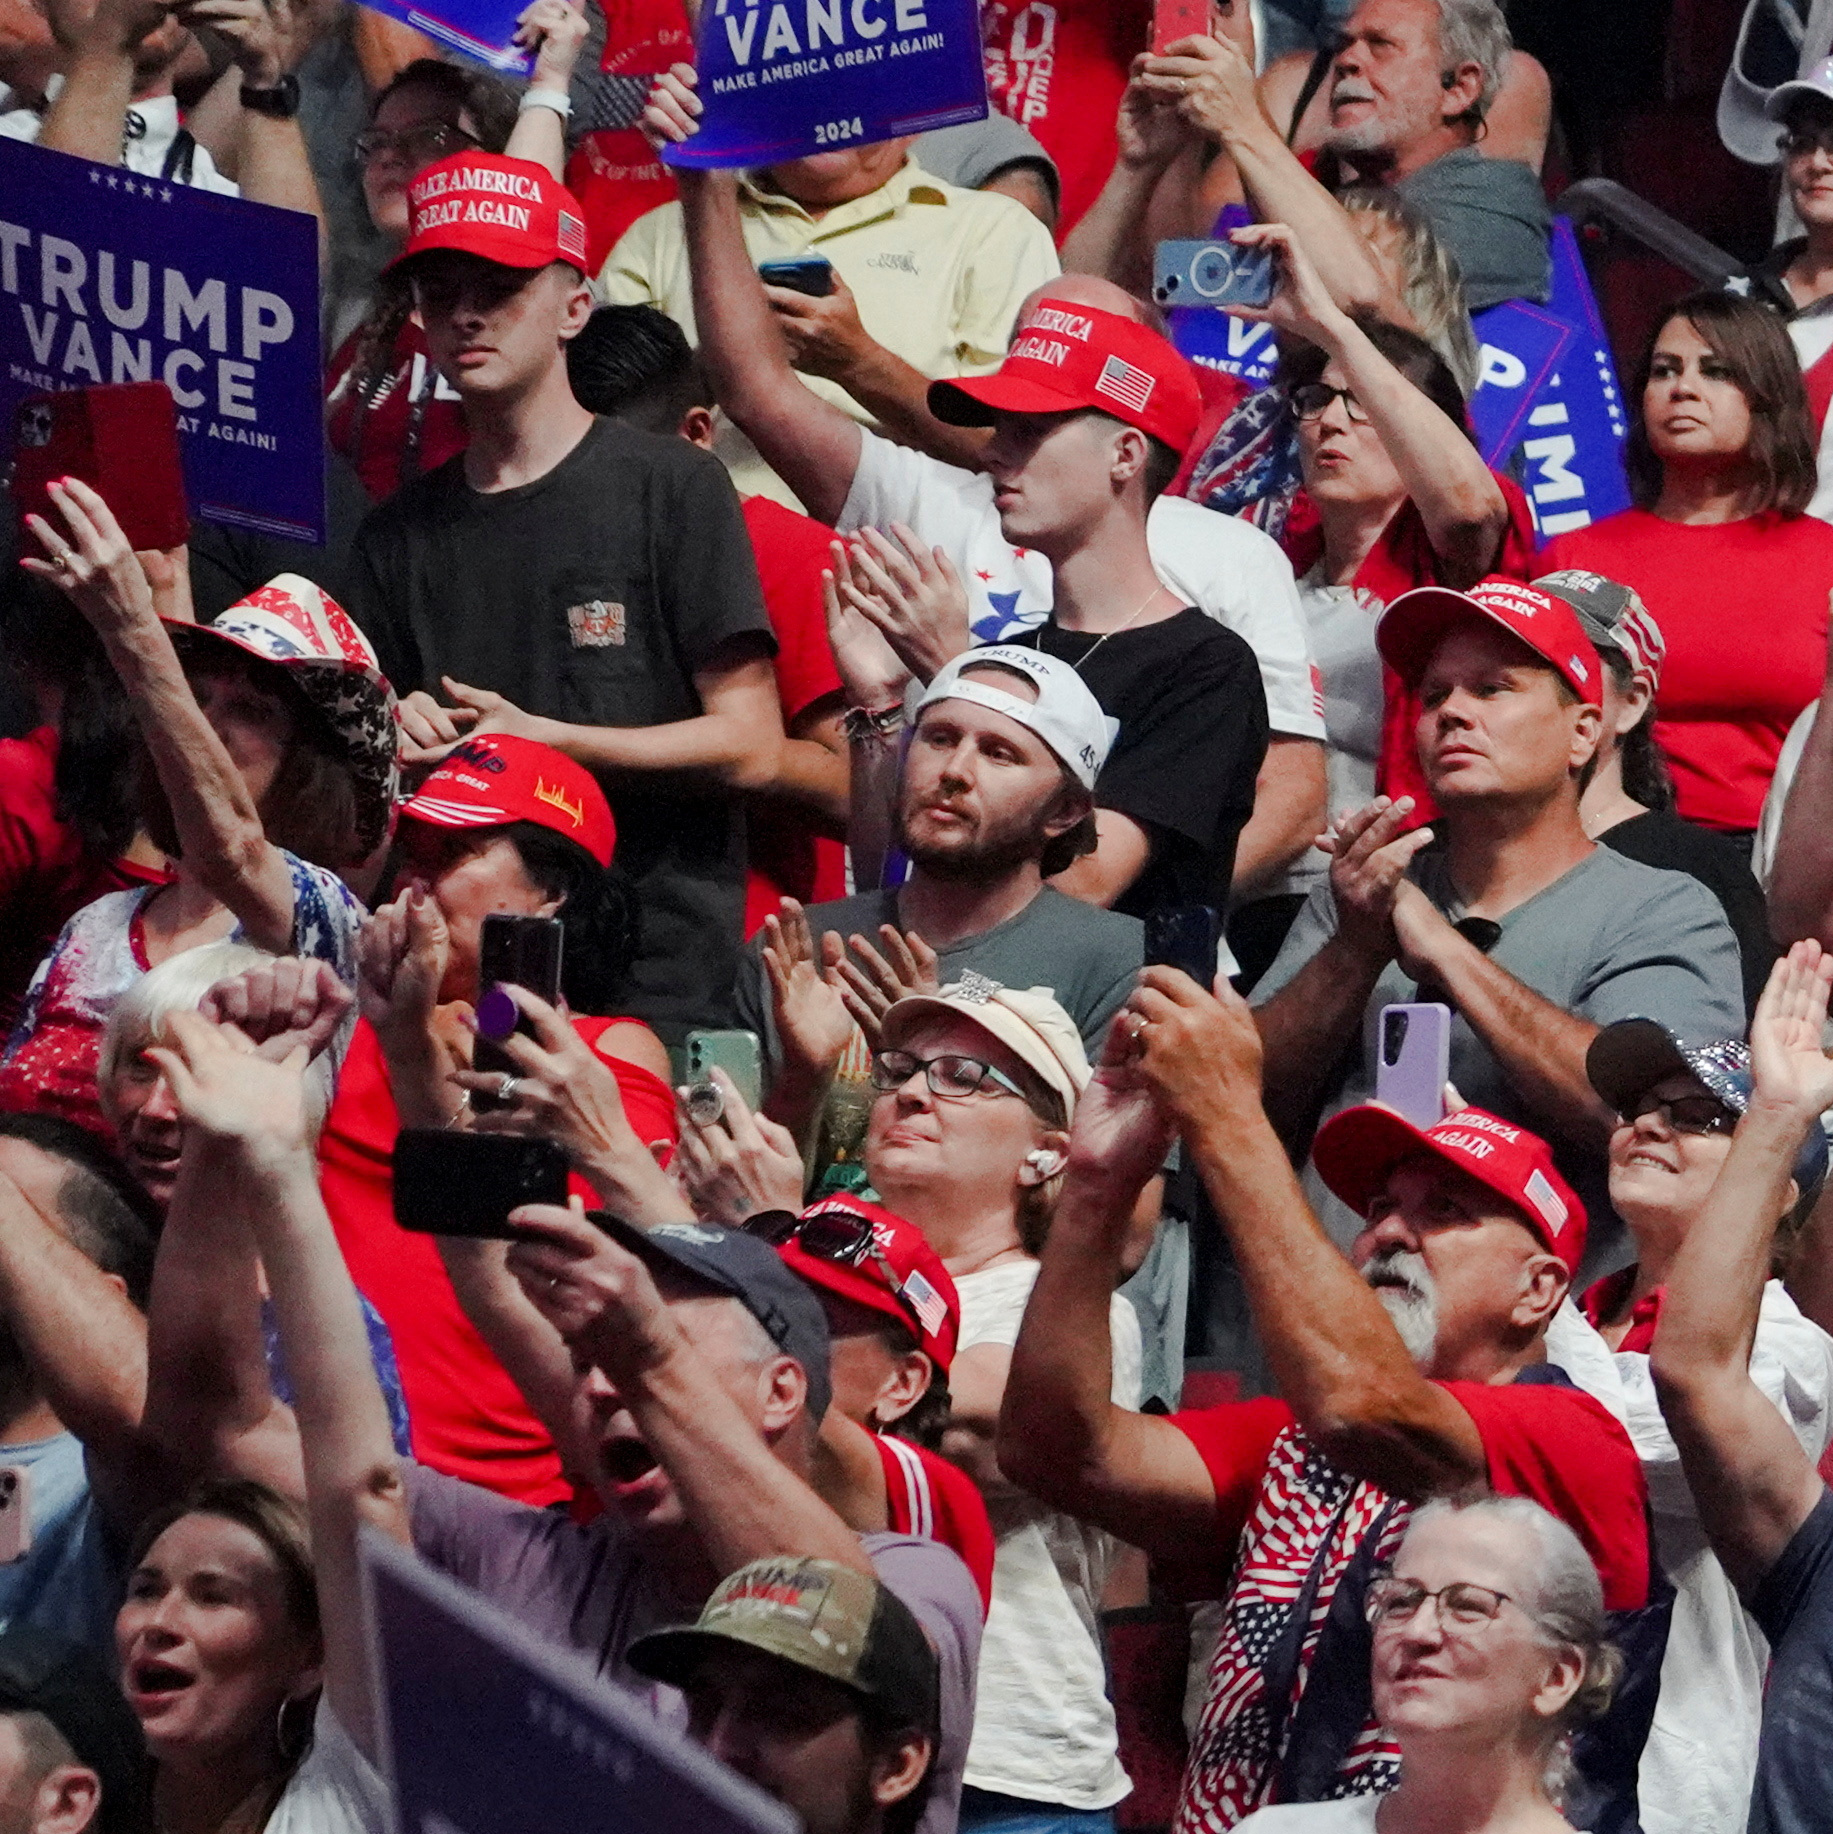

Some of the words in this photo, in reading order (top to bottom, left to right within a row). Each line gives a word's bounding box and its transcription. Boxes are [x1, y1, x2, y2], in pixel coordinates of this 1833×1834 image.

[724, 0, 928, 67] VANCE
[712, 73, 756, 93] MAKE
[761, 57, 830, 84] AMERICA
[834, 47, 884, 70] GREAT
[889, 31, 945, 58] AGAIN!
[814, 116, 864, 143] 2024
[451, 167, 543, 203] AMERICA
[463, 199, 531, 232] AGAIN
[0, 221, 294, 363] TRUMP
[19, 303, 257, 423] VANCE
[206, 417, 278, 453] AGAIN!
[1479, 594, 1538, 619] AGAIN
[1432, 1130, 1496, 1159] AGAIN
